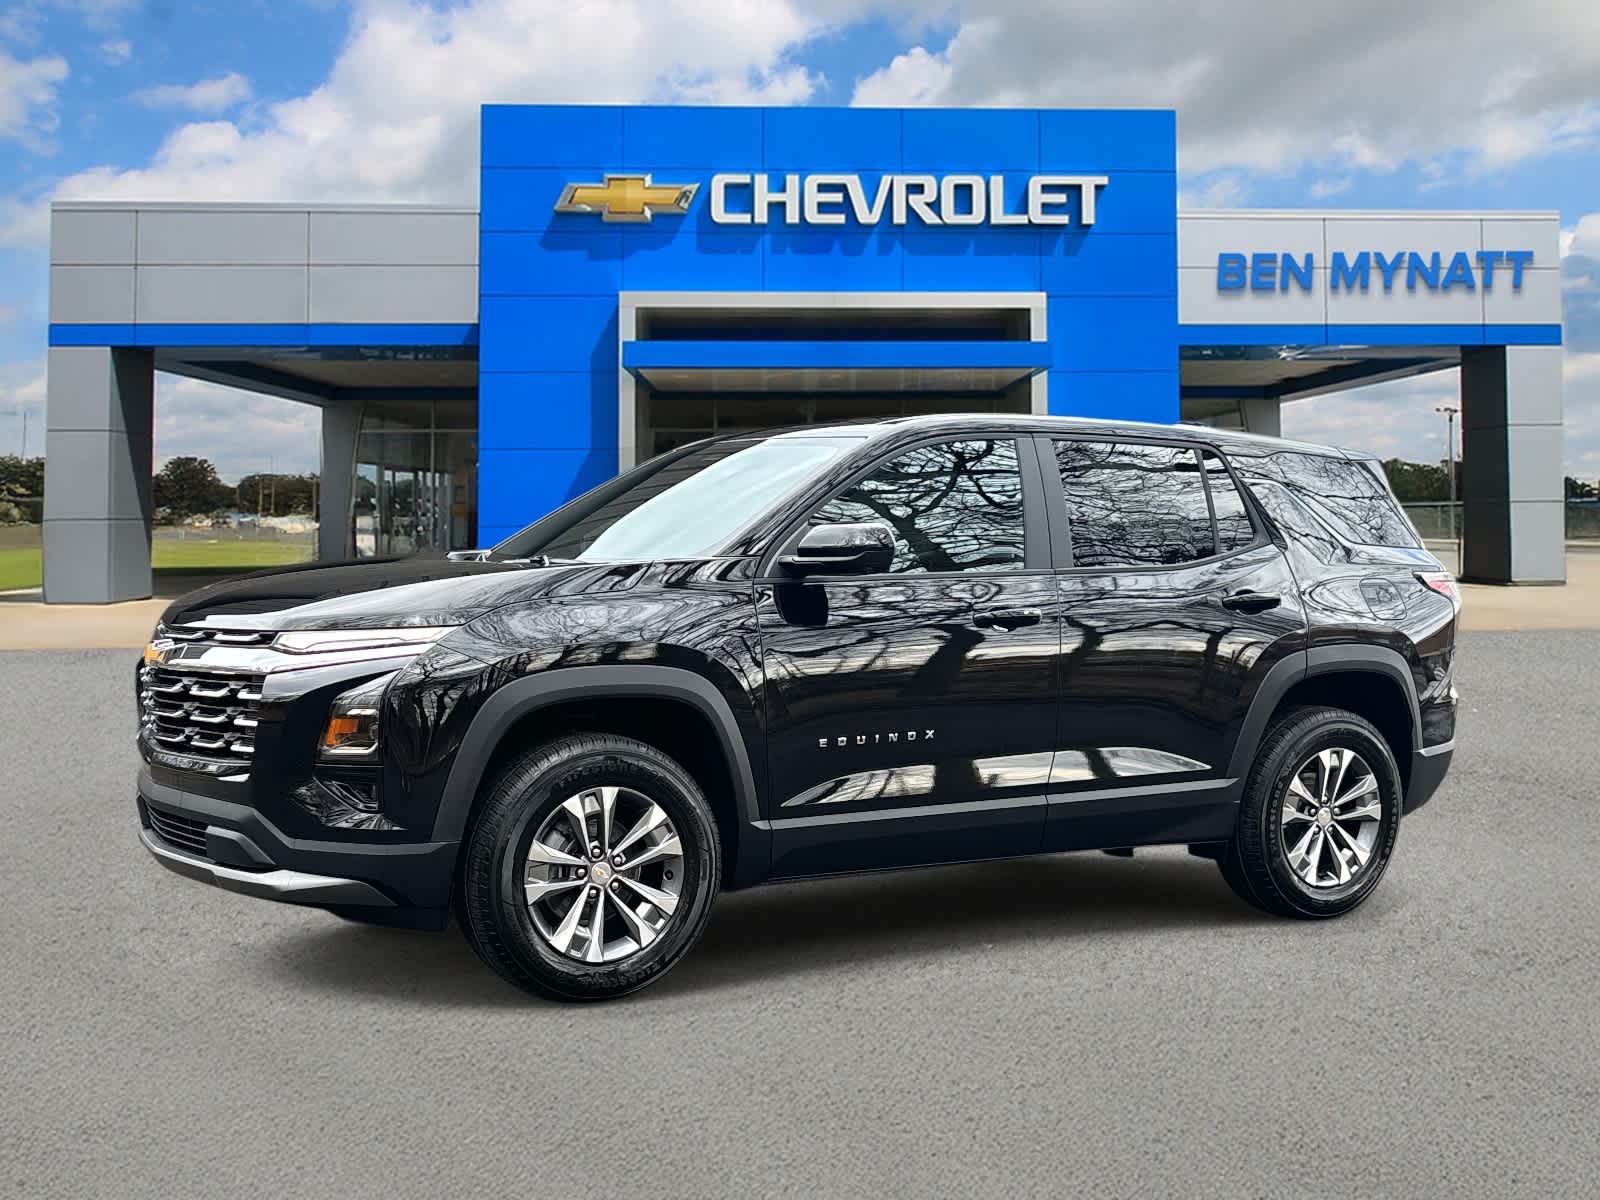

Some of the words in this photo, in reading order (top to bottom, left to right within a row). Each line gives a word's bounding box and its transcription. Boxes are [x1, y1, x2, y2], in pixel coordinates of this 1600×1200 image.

[711, 173, 1109, 226] CHEVROLET
[1216, 251, 1313, 291] BEN
[1330, 250, 1534, 291] MYNATT
[818, 729, 936, 748] EQUINOX
